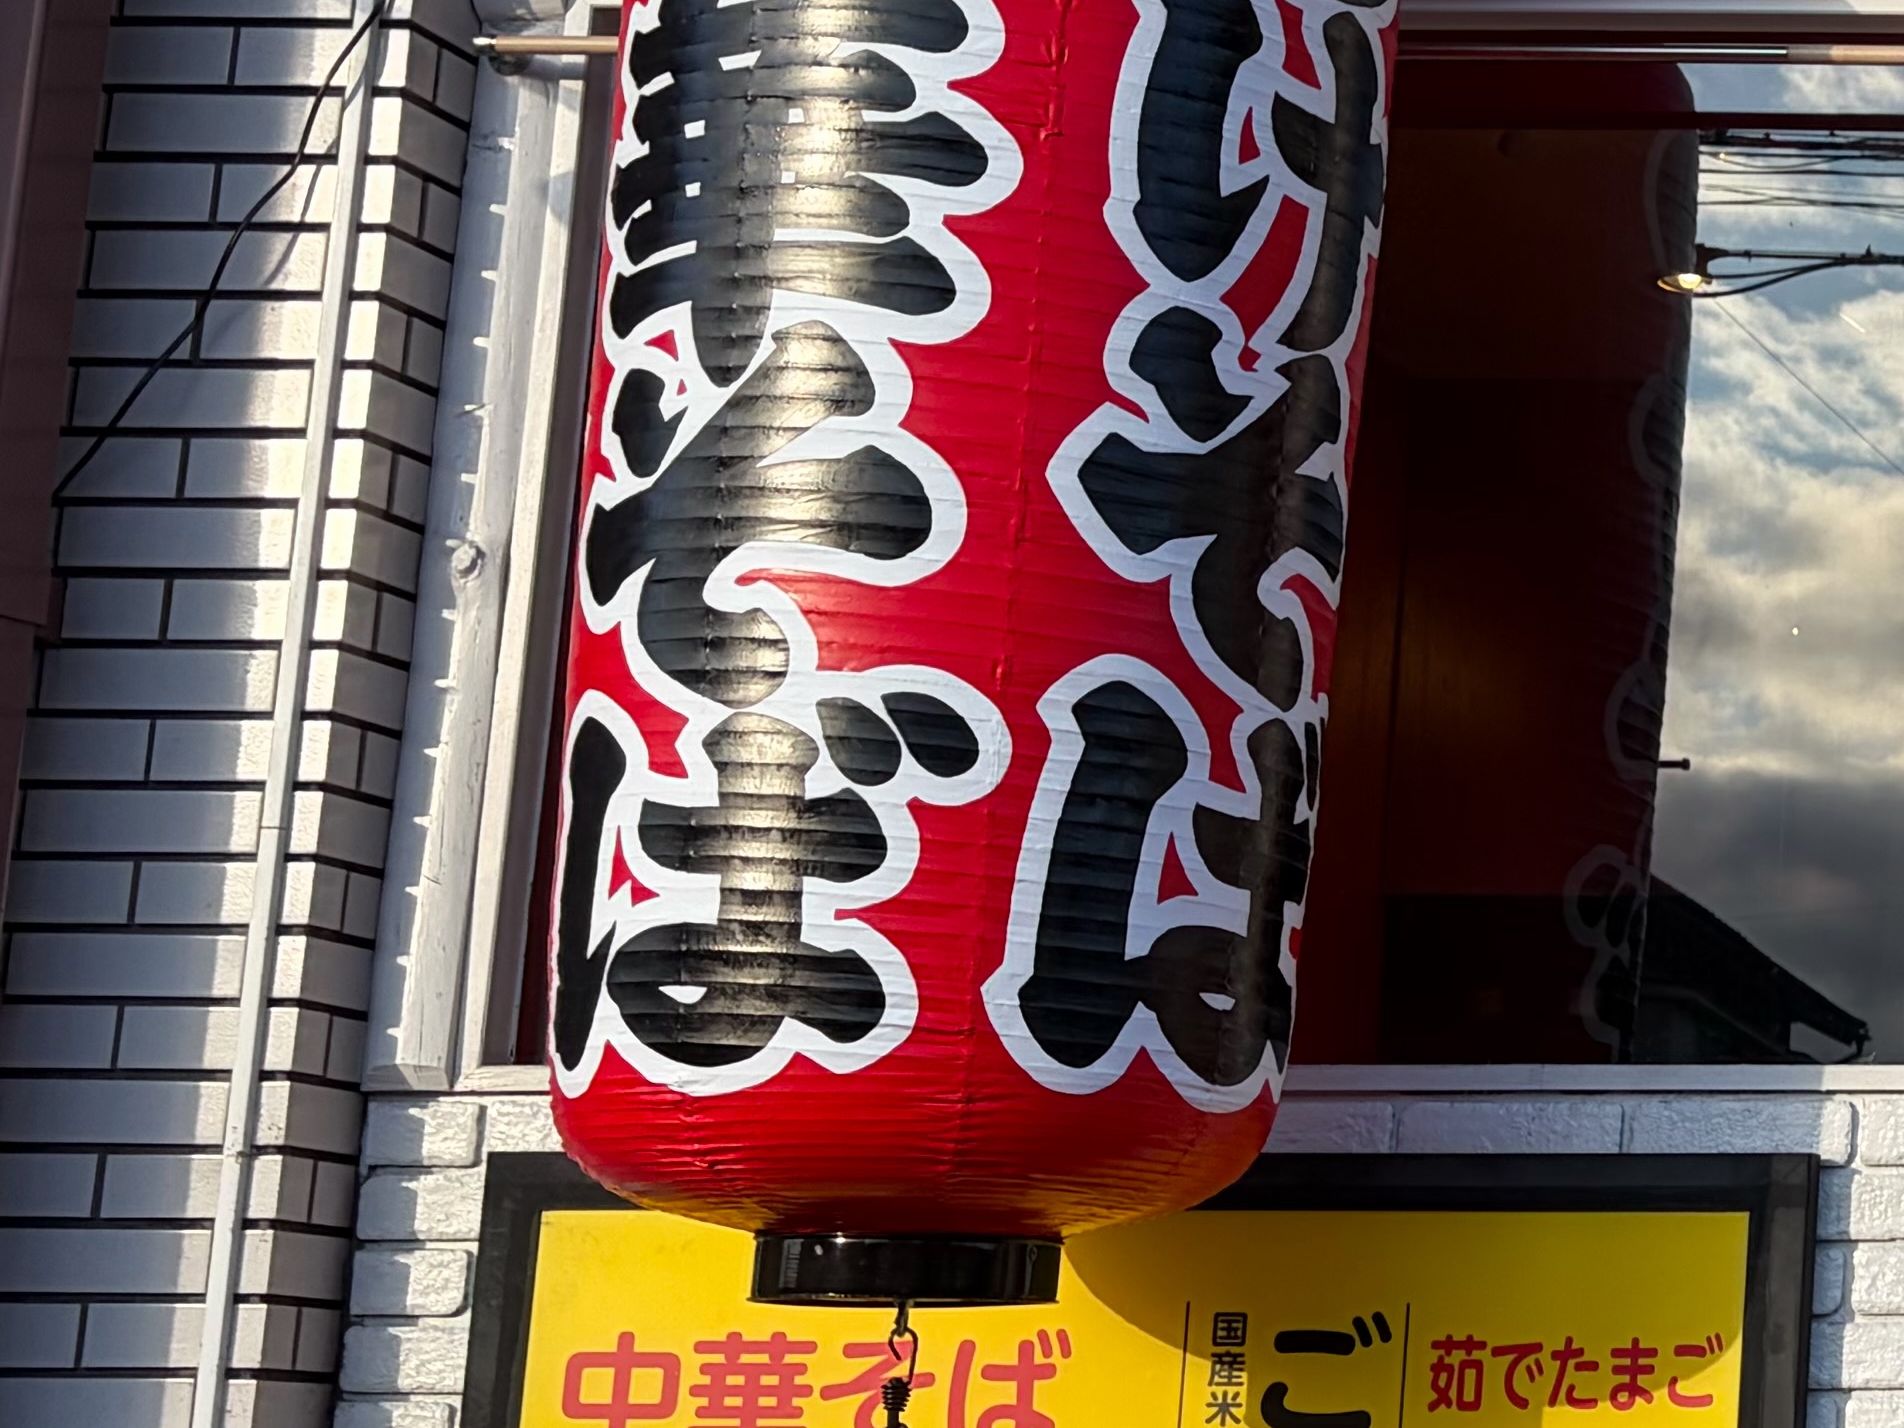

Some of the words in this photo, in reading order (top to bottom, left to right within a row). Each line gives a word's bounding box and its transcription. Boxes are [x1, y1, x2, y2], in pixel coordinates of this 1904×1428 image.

[1427, 1334, 1724, 1412] 茹でたまご
